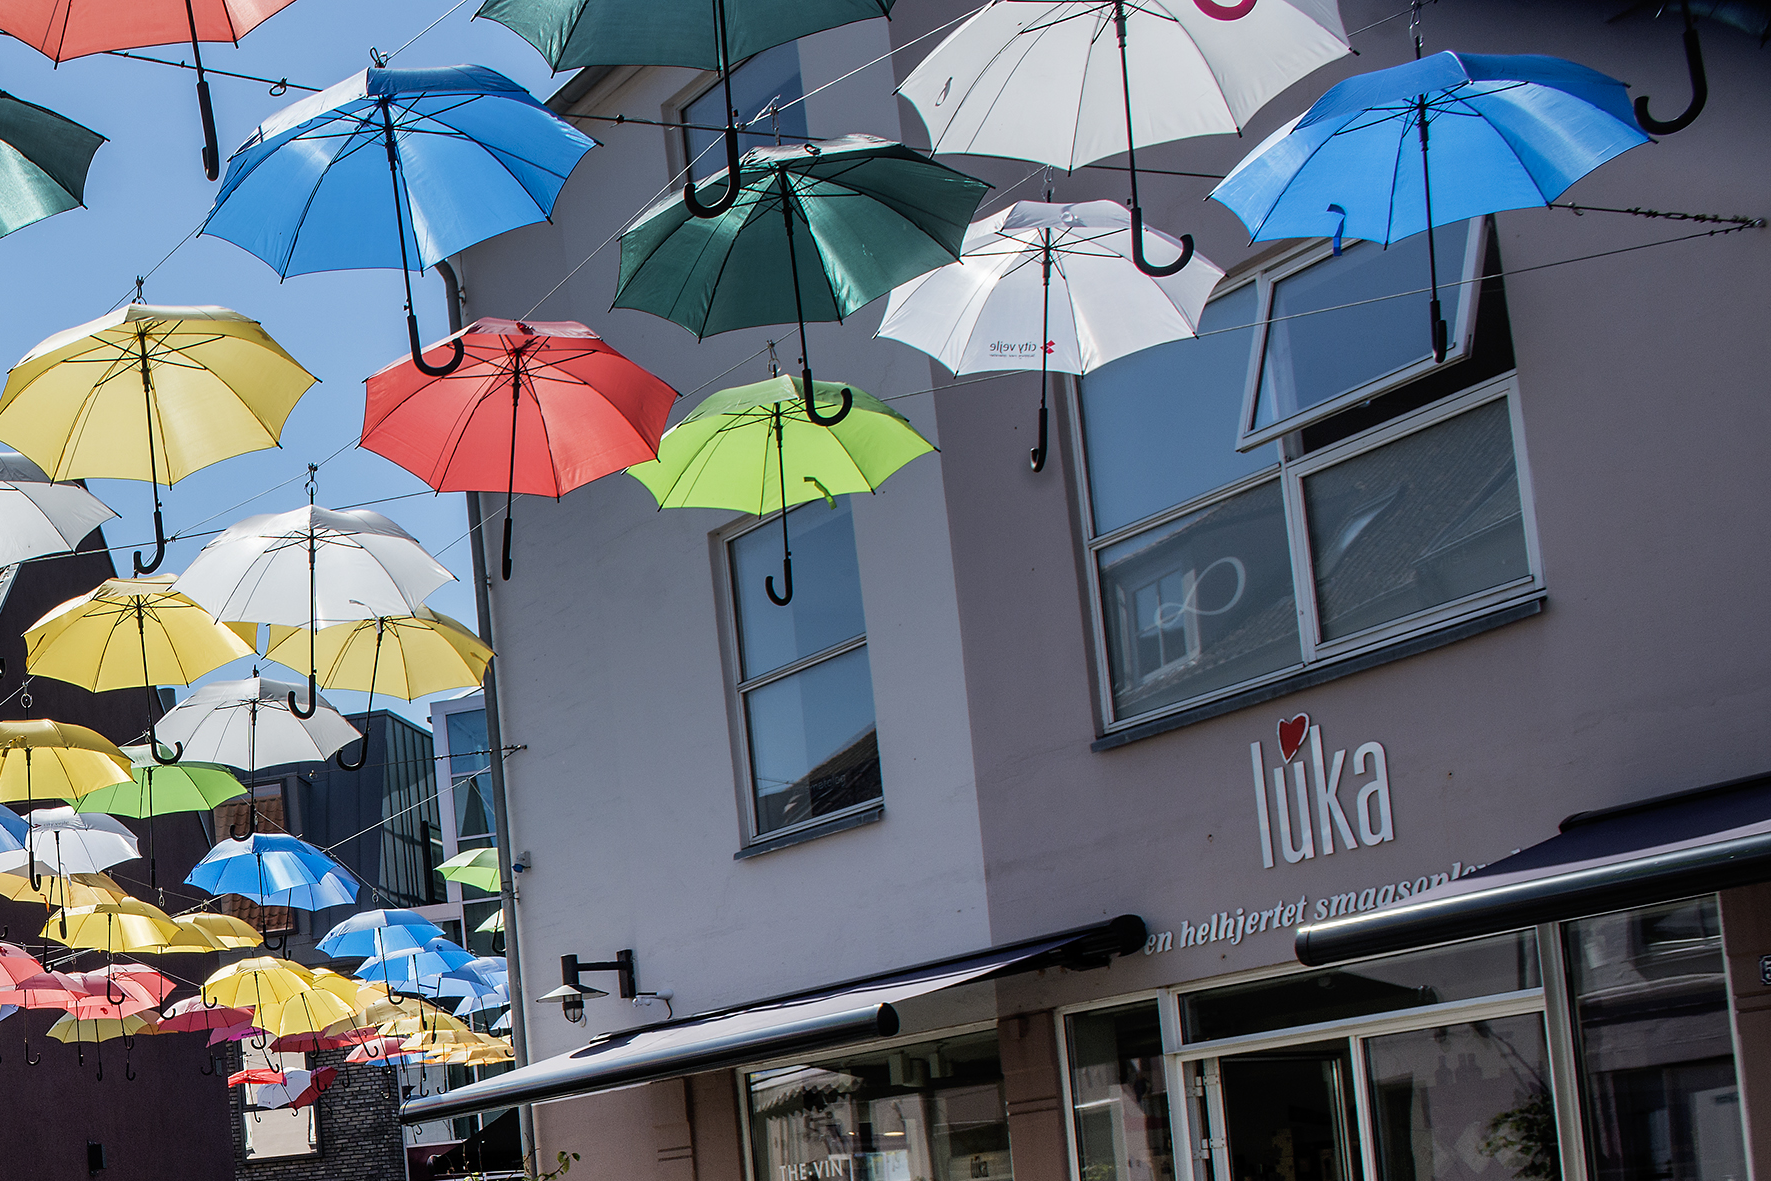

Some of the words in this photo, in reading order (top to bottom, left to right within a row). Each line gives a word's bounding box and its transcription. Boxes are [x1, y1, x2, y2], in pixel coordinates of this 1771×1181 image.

[1250, 724, 1395, 869] luka
[1144, 929, 1173, 956] en
[1180, 895, 1308, 949] helhjertet
